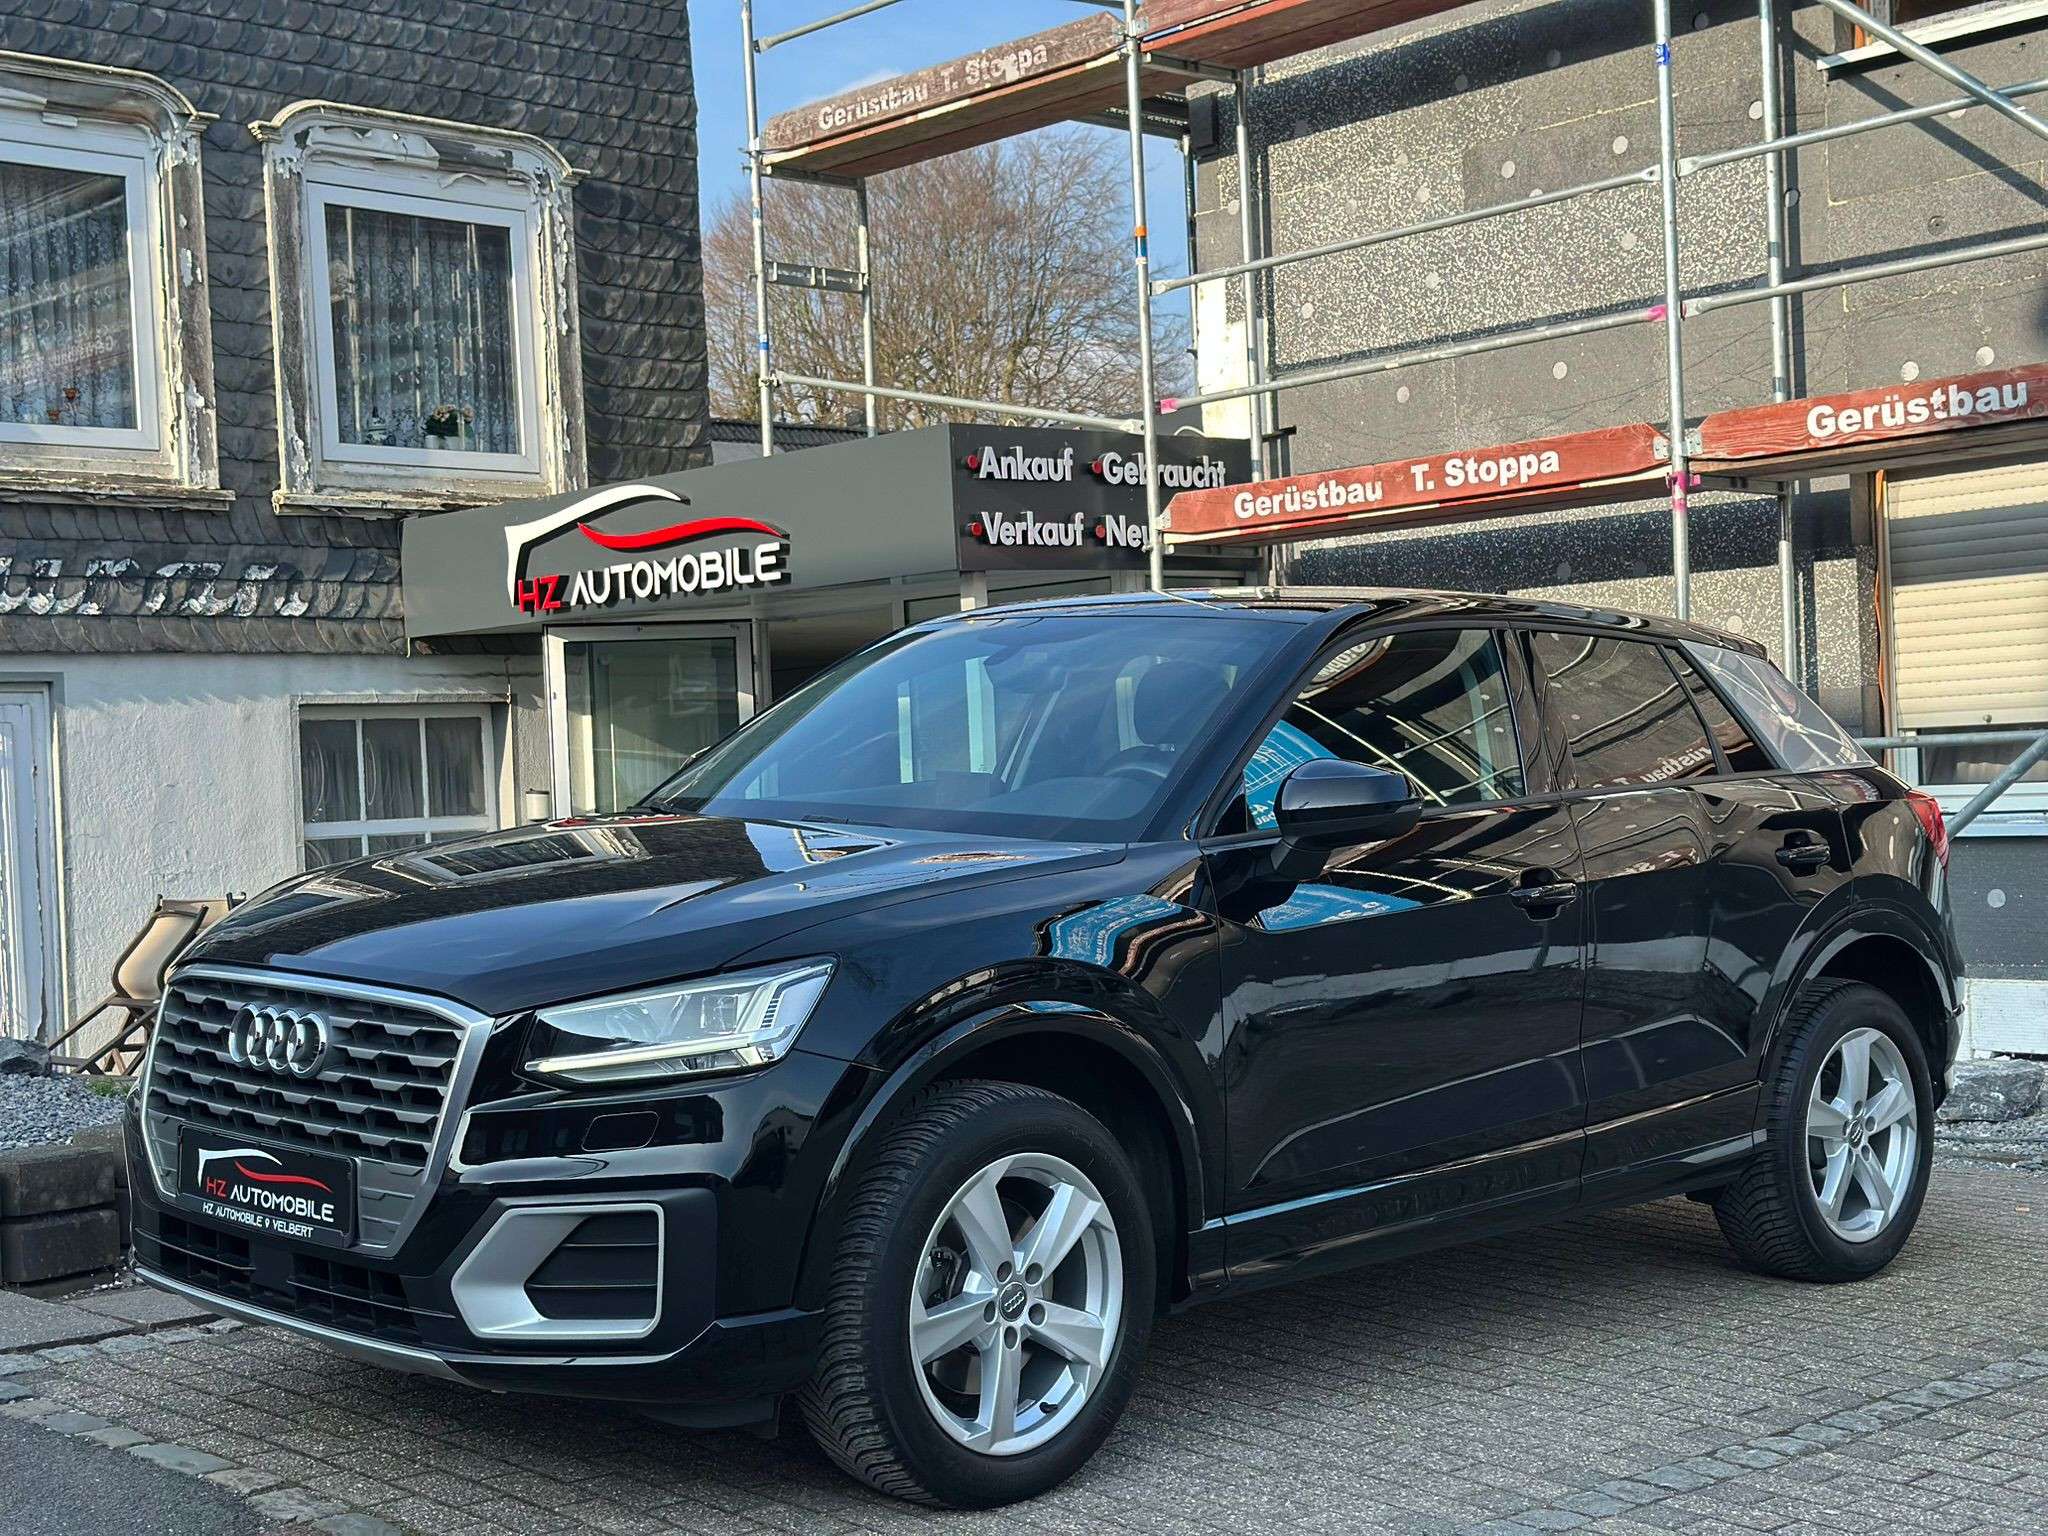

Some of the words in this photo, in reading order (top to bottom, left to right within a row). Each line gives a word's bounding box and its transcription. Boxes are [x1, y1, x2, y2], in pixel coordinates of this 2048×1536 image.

[818, 84, 929, 131] Gerüstbau
[1806, 382, 2029, 438] Gerüstbau
[979, 445, 1074, 482] Ankauf
[1233, 478, 1384, 520] Gerüstbau
[1410, 464, 1436, 493] T.
[1444, 450, 1560, 488] Stoppa
[980, 511, 1085, 547] Verkauf
[517, 574, 565, 614] HZ
[570, 541, 786, 607] AUTOMOBILE
[202, 1202, 214, 1215] HZ
[215, 1206, 264, 1228] AUTOMOBILE
[273, 1219, 314, 1239] VELBERT
[205, 1176, 228, 1198] HZ
[230, 1184, 335, 1223] AUTOMOBILE
